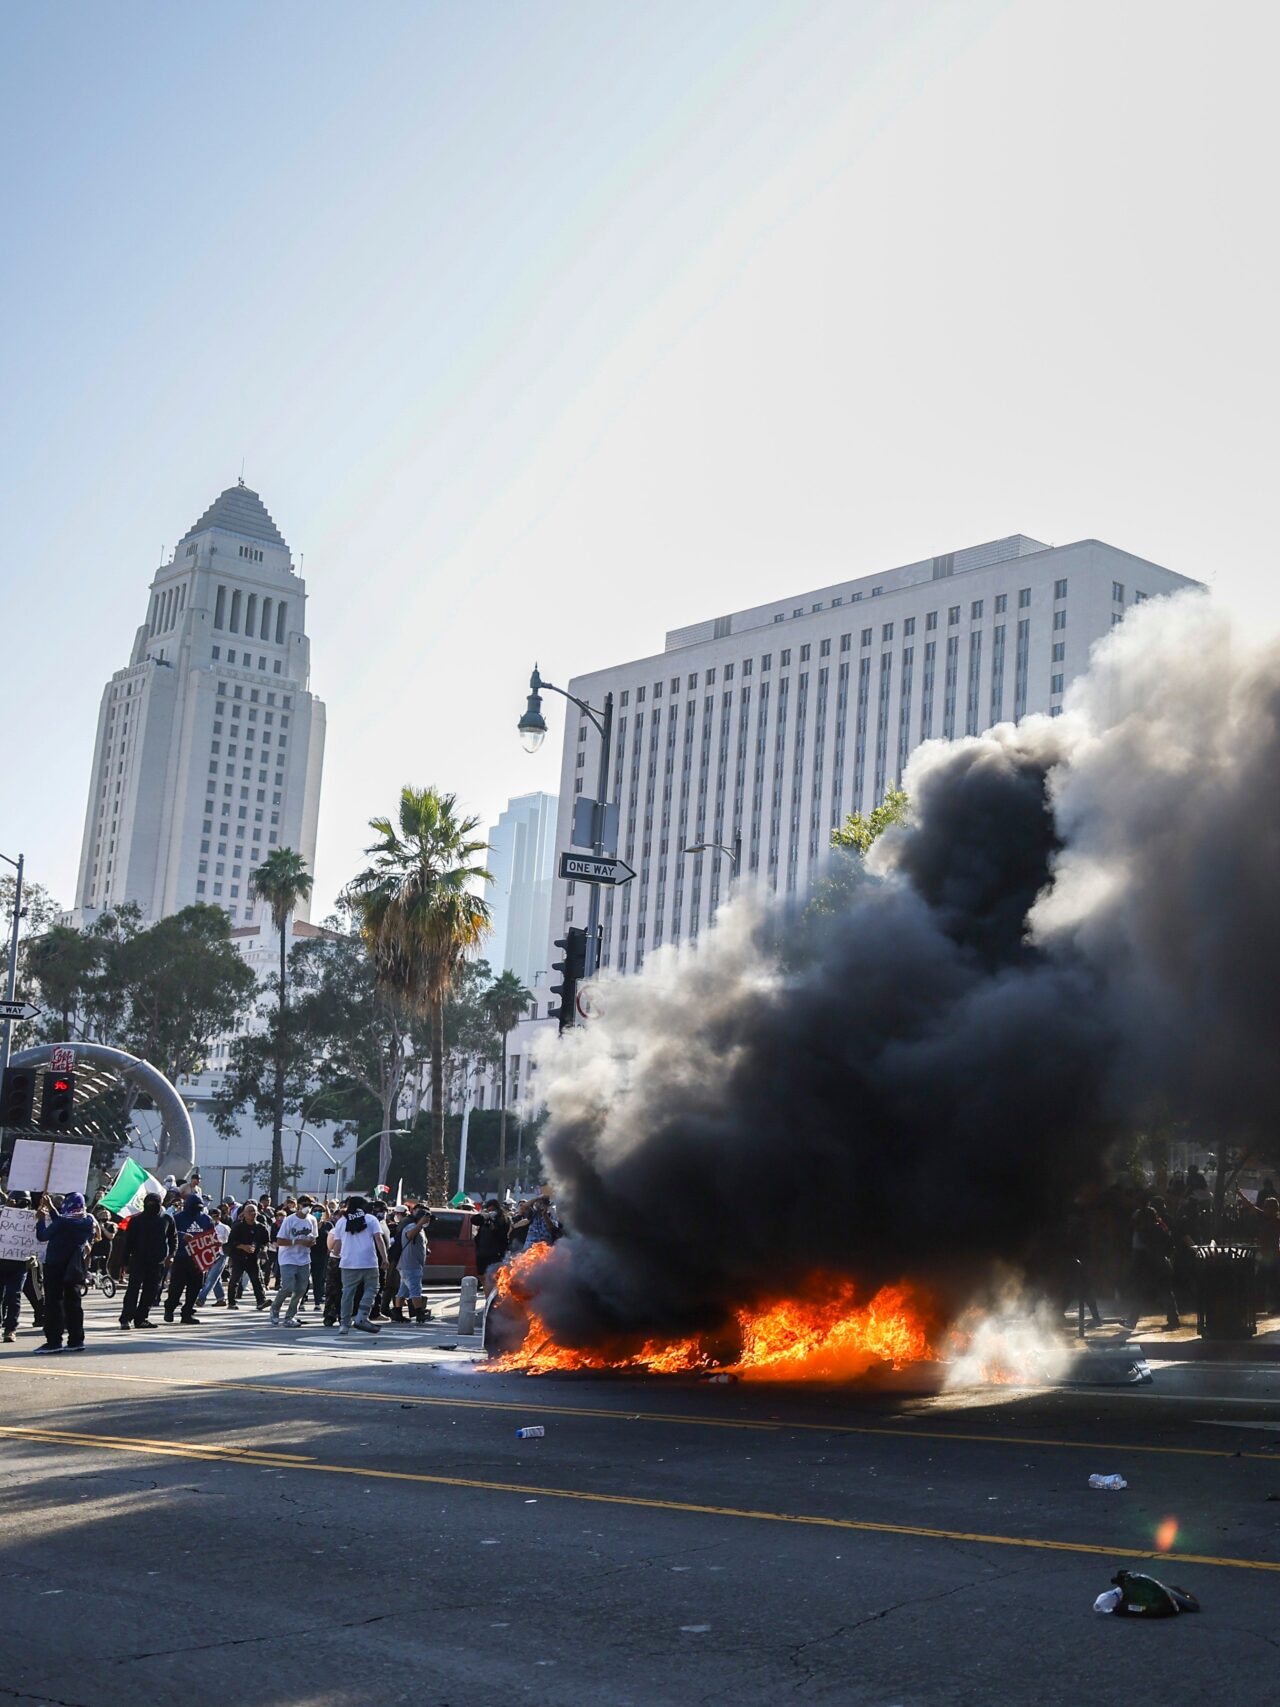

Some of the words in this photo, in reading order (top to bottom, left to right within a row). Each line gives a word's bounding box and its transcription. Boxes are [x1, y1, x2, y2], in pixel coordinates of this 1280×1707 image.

[569, 861, 590, 873] ONE
[593, 865, 615, 876] WAY
[17, 1210, 36, 1220] STA
[0, 1220, 36, 1233] RACIS
[9, 1235, 35, 1247] STA
[188, 1231, 219, 1255] FUCK
[194, 1245, 222, 1271] ICE
